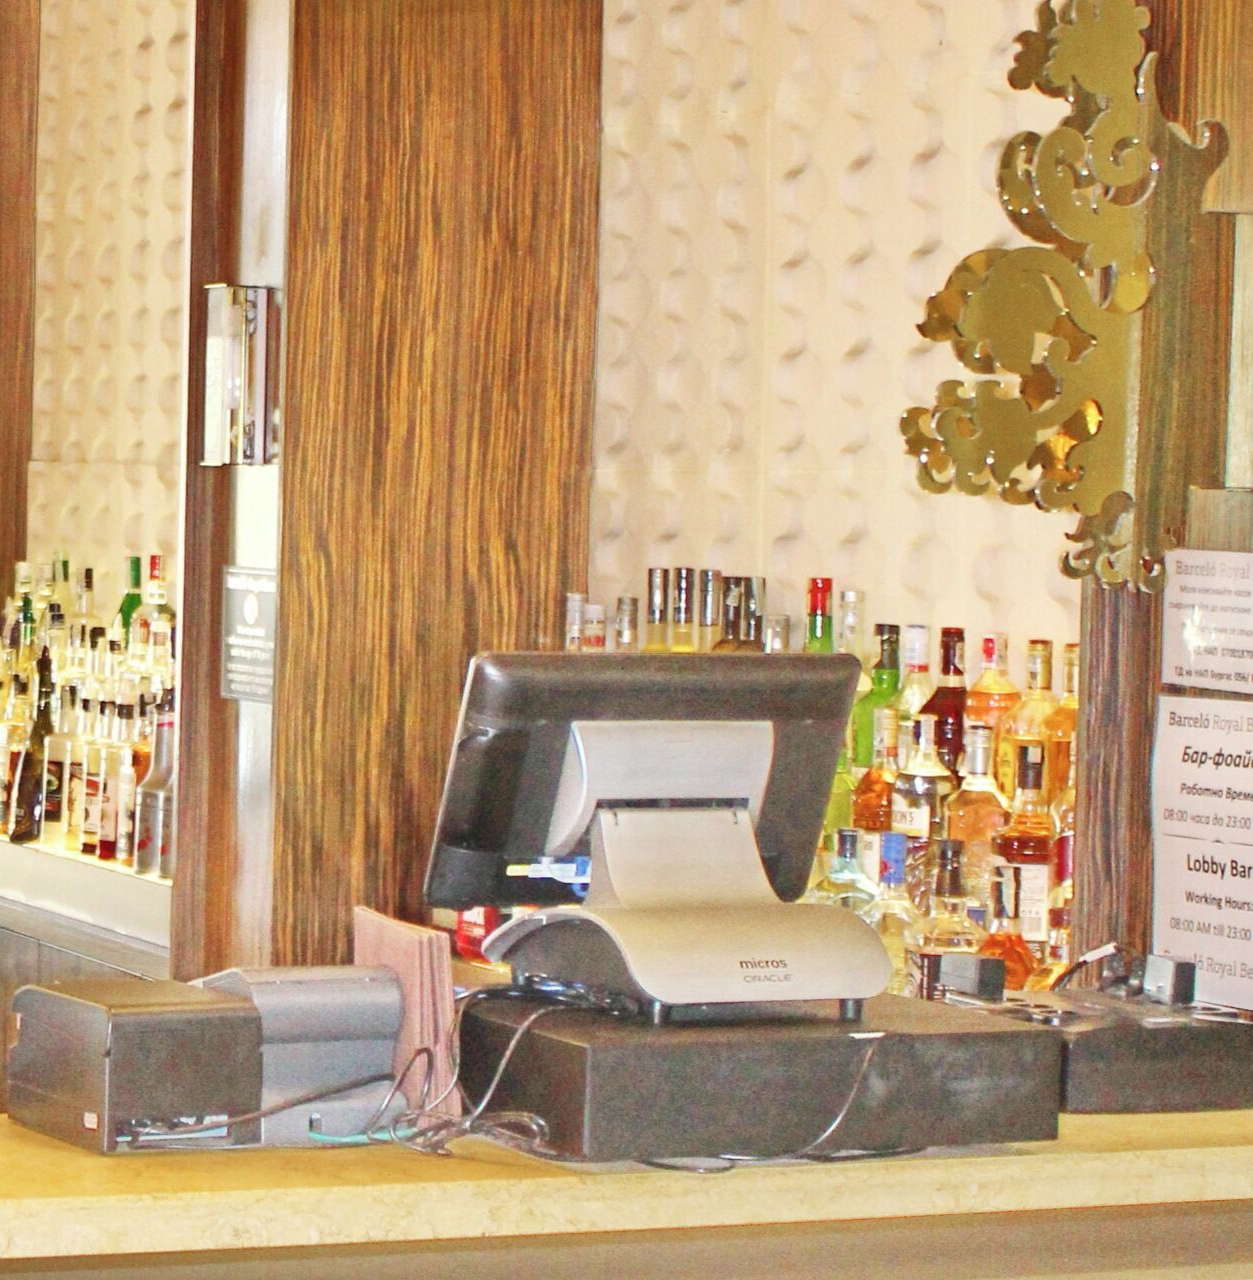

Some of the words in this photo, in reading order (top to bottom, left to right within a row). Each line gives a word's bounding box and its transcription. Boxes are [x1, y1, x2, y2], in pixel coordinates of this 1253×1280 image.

[1175, 560, 1217, 577] Barceló
[1168, 711, 1210, 729] Barceló
[1212, 714, 1244, 735] Royal
[1180, 782, 1224, 798] Работно
[1163, 808, 1188, 822] 08:00
[1226, 815, 1251, 830] 23:00
[1187, 854, 1226, 880] Lobby
[1230, 860, 1252, 879] Bar
[1185, 890, 1223, 910] Working
[1169, 917, 1194, 934] 08:00
[1196, 921, 1211, 935] AM
[1213, 923, 1224, 937] till
[1227, 925, 1251, 941] 23:00
[739, 956, 788, 969] micros
[1206, 958, 1237, 979] Royal
[743, 973, 793, 983] ORACLE
